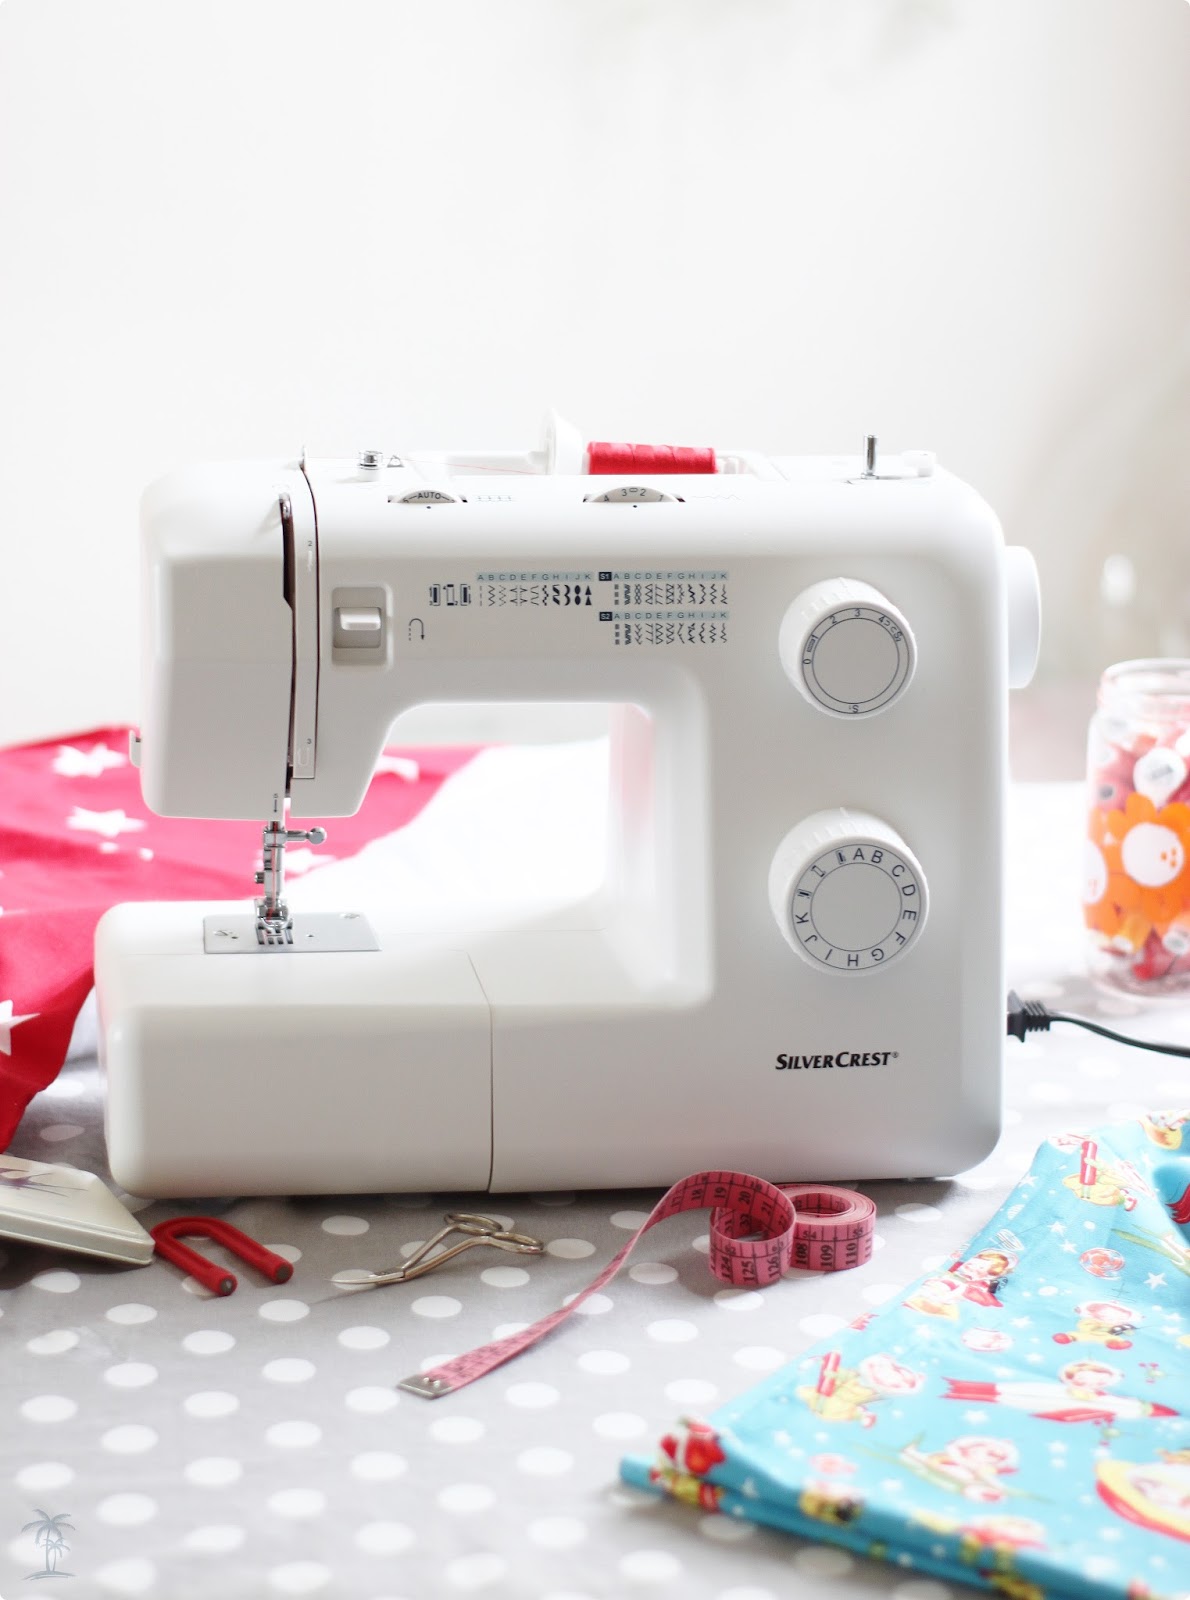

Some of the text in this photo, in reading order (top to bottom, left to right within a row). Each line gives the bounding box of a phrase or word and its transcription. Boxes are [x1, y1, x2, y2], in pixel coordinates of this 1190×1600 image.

[417, 491, 441, 500] AUTO
[621, 488, 628, 497] 3
[639, 488, 647, 497] 2
[600, 612, 610, 620] S2
[829, 615, 837, 624] 2
[854, 608, 861, 618] 3
[795, 847, 917, 967] A B C D E F G H I J K
[713, 1186, 727, 1199] 19
[737, 1190, 752, 1205] 20
[795, 1242, 808, 1265] 108
[820, 1244, 833, 1267] 109
[845, 1242, 858, 1266] 110
[741, 1260, 755, 1282] 125
[767, 1255, 780, 1279] 126
